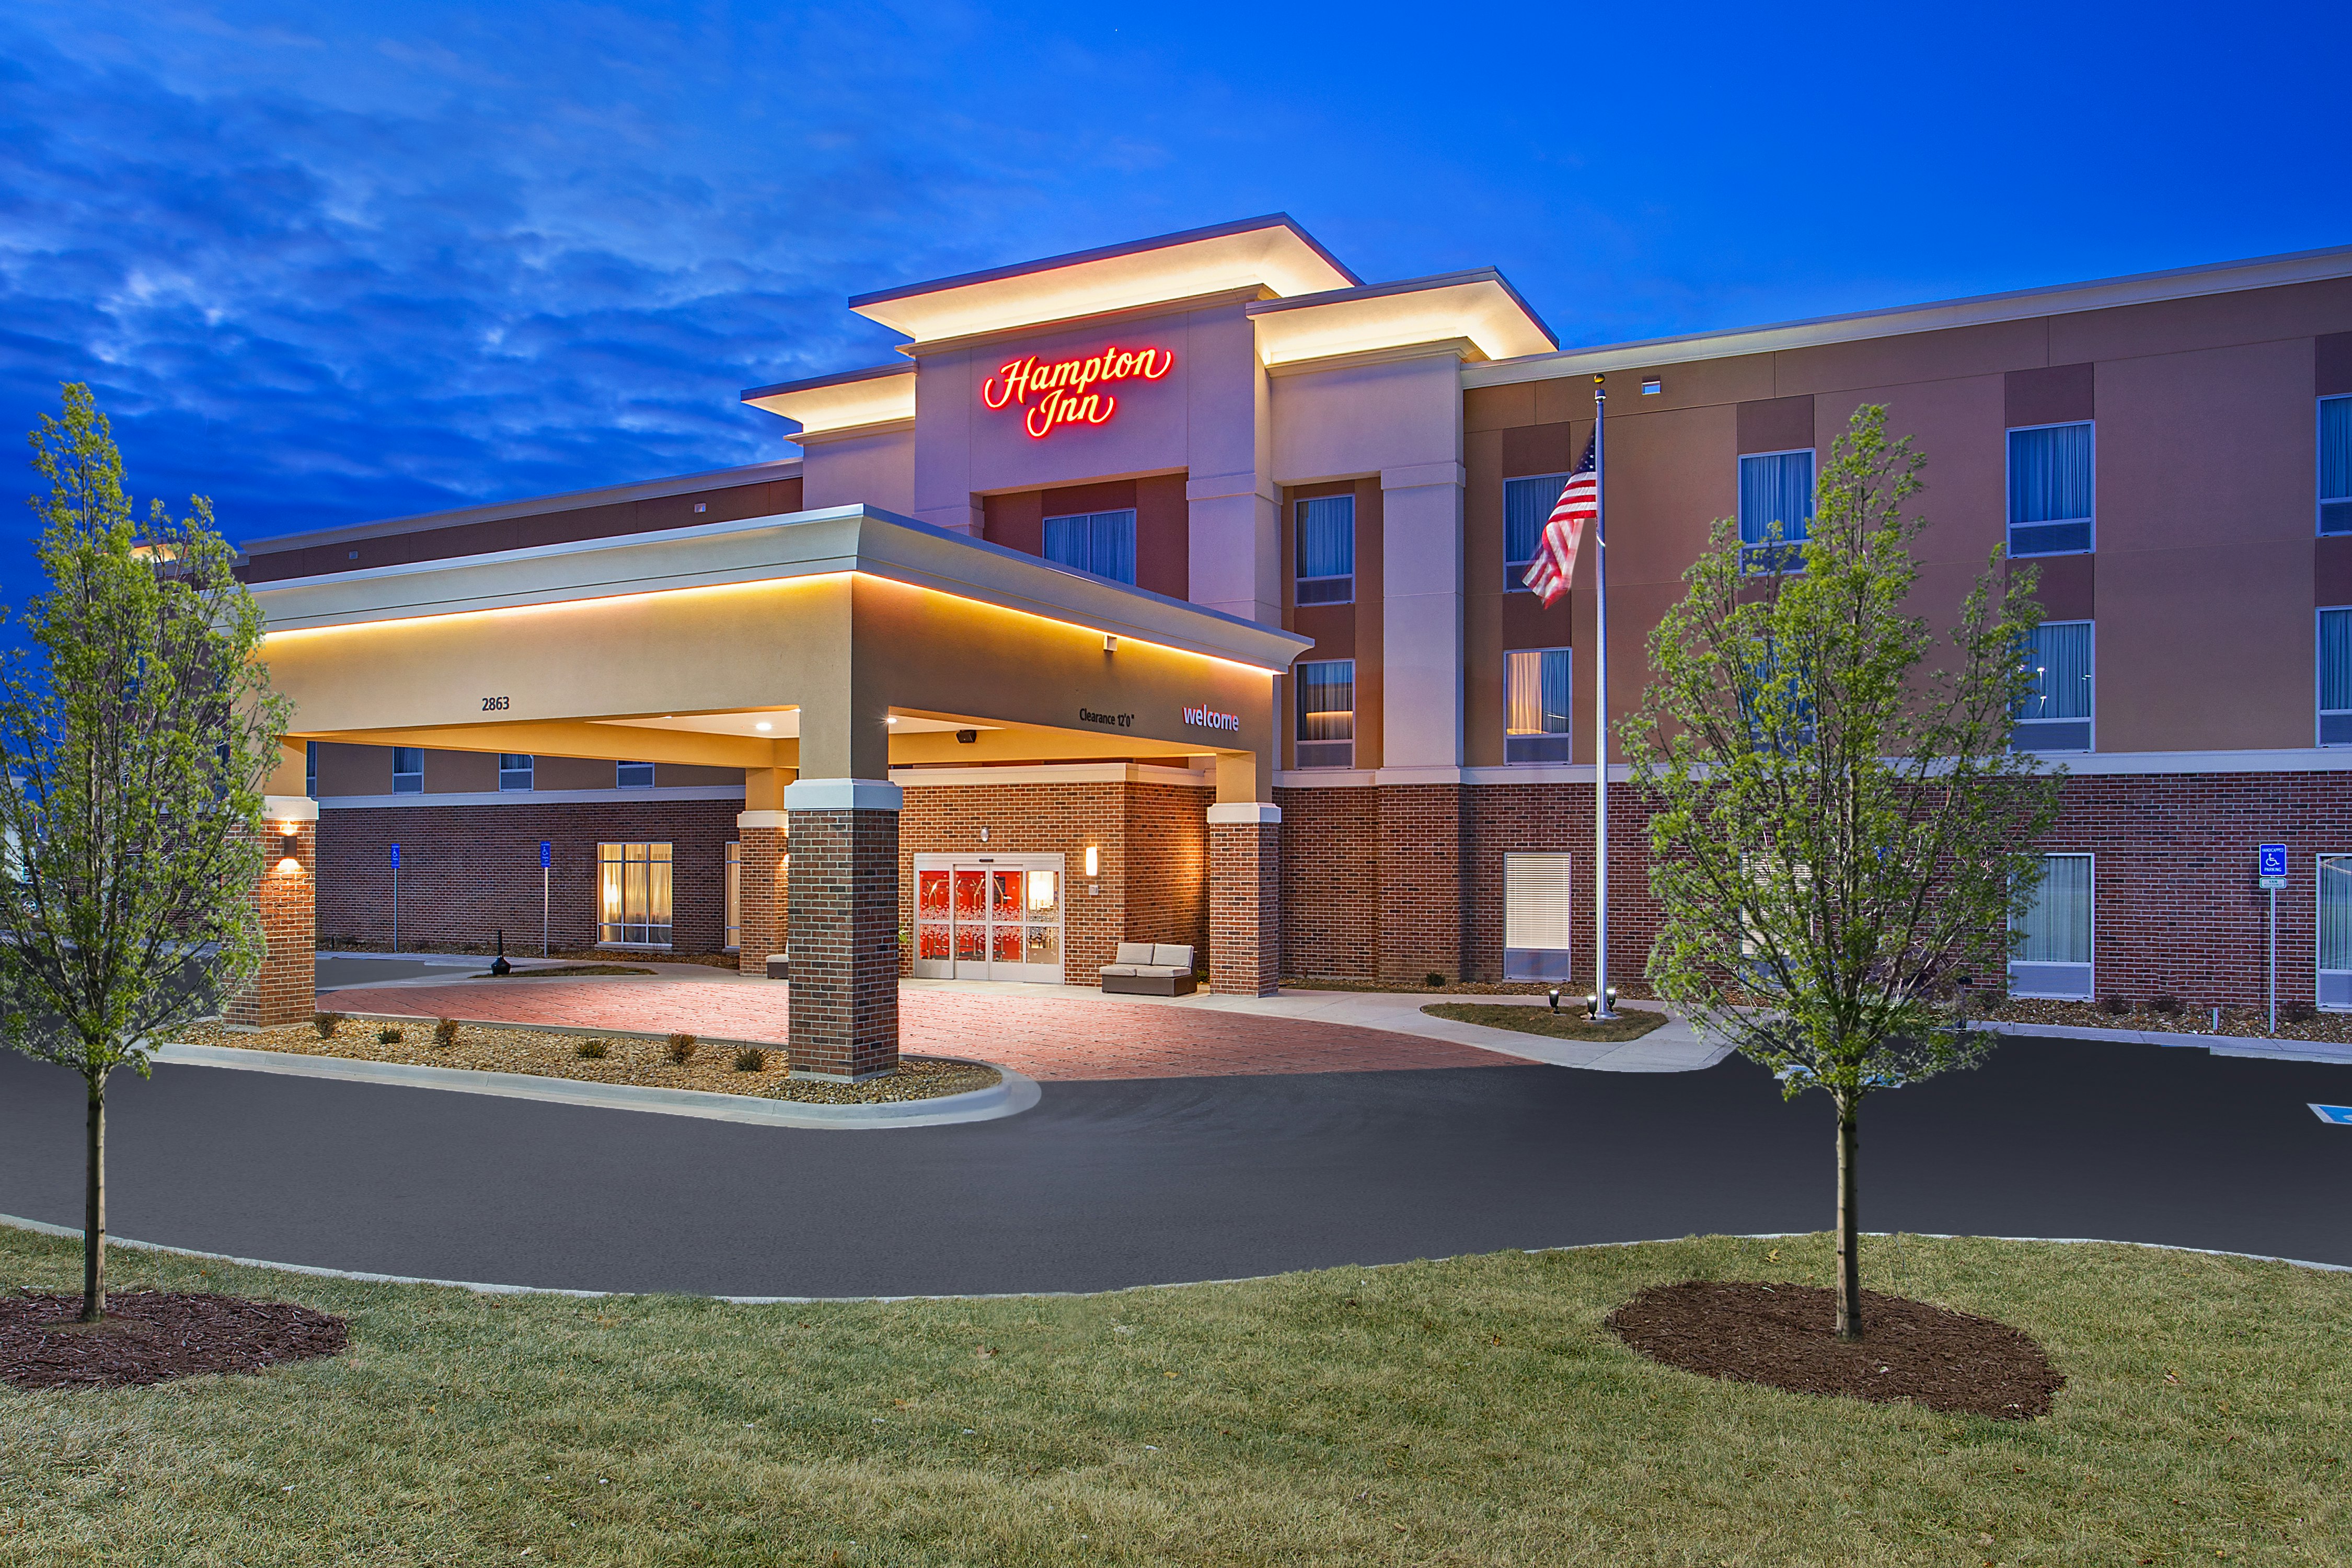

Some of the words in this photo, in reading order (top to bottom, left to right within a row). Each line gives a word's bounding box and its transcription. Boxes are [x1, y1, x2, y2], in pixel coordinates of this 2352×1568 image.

[984, 347, 1172, 408] Hampton
[1027, 389, 1114, 437] Inn
[482, 696, 510, 711] 2863
[1079, 708, 1115, 725] Clearance
[1117, 713, 1135, 728] 12'0"
[1182, 704, 1239, 731] welcome
